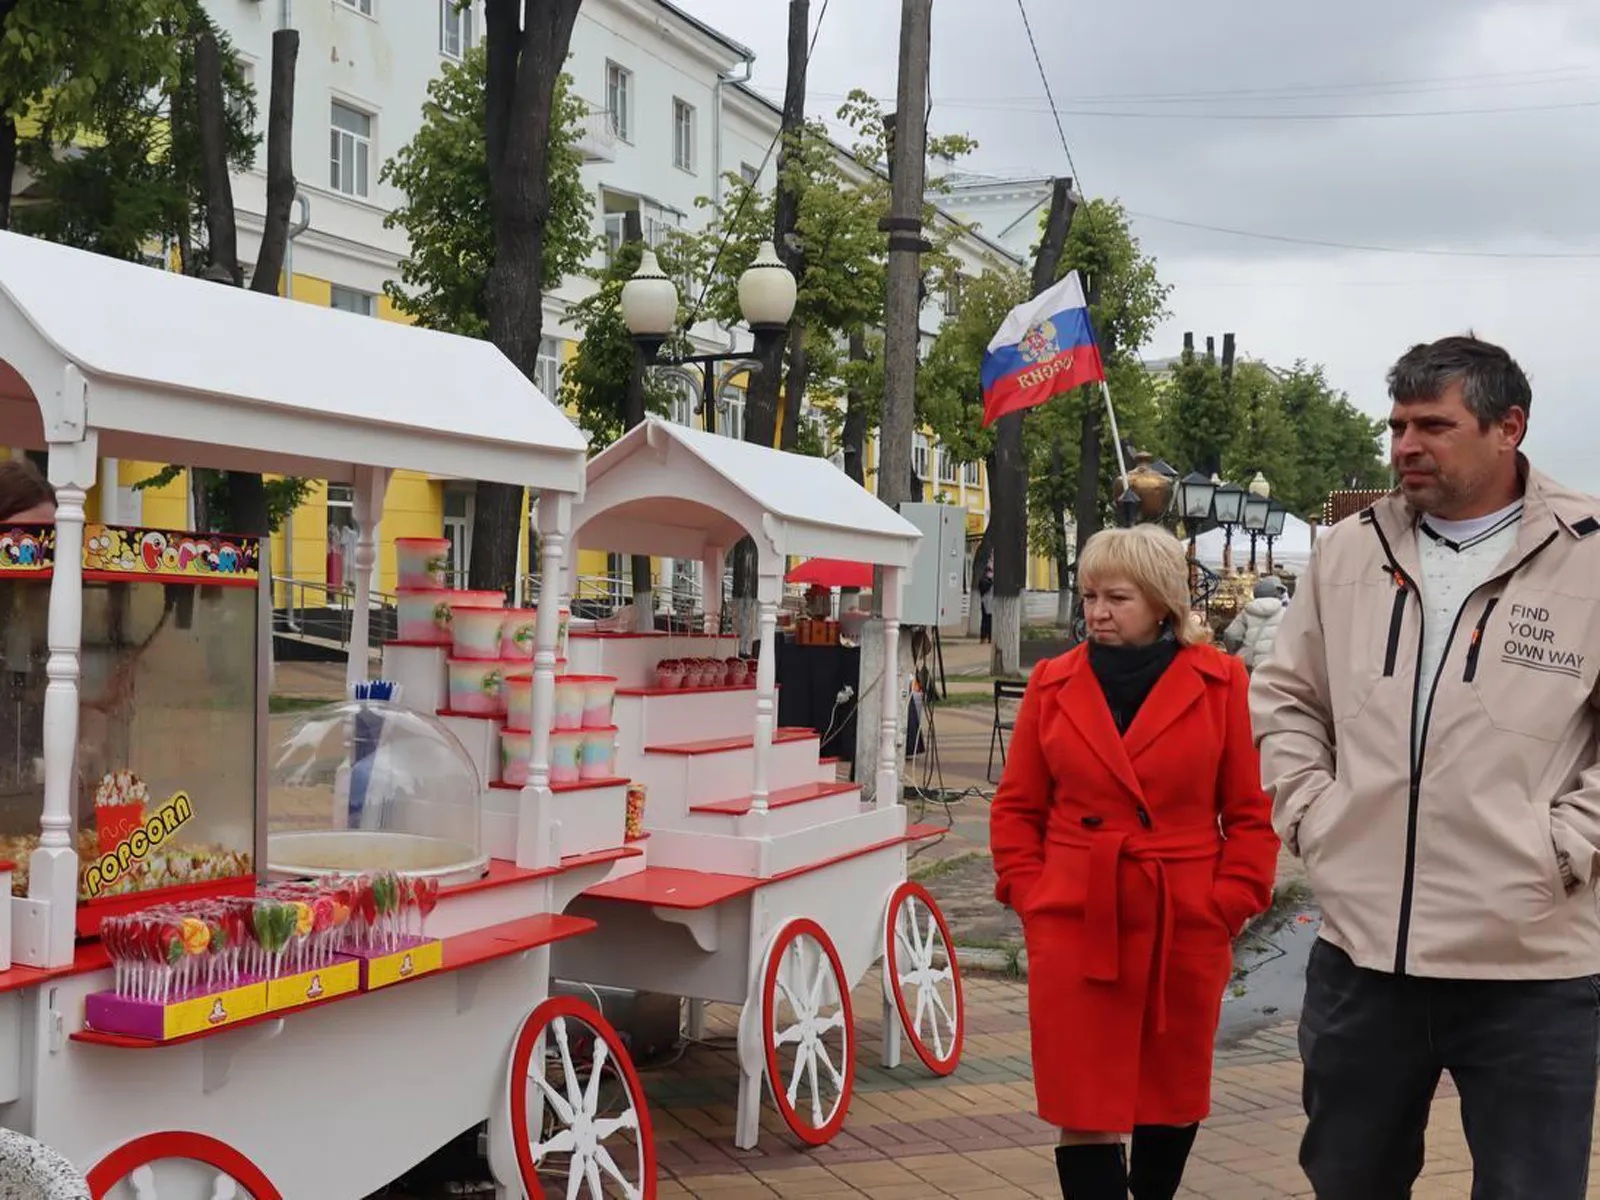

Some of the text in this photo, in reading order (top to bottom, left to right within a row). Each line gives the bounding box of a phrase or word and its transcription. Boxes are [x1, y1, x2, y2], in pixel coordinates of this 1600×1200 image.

[1510, 604, 1550, 622] FIND
[1508, 621, 1555, 644] YOUR
[1504, 640, 1585, 669] OWN WAY
[85, 793, 192, 898] POPCORN
